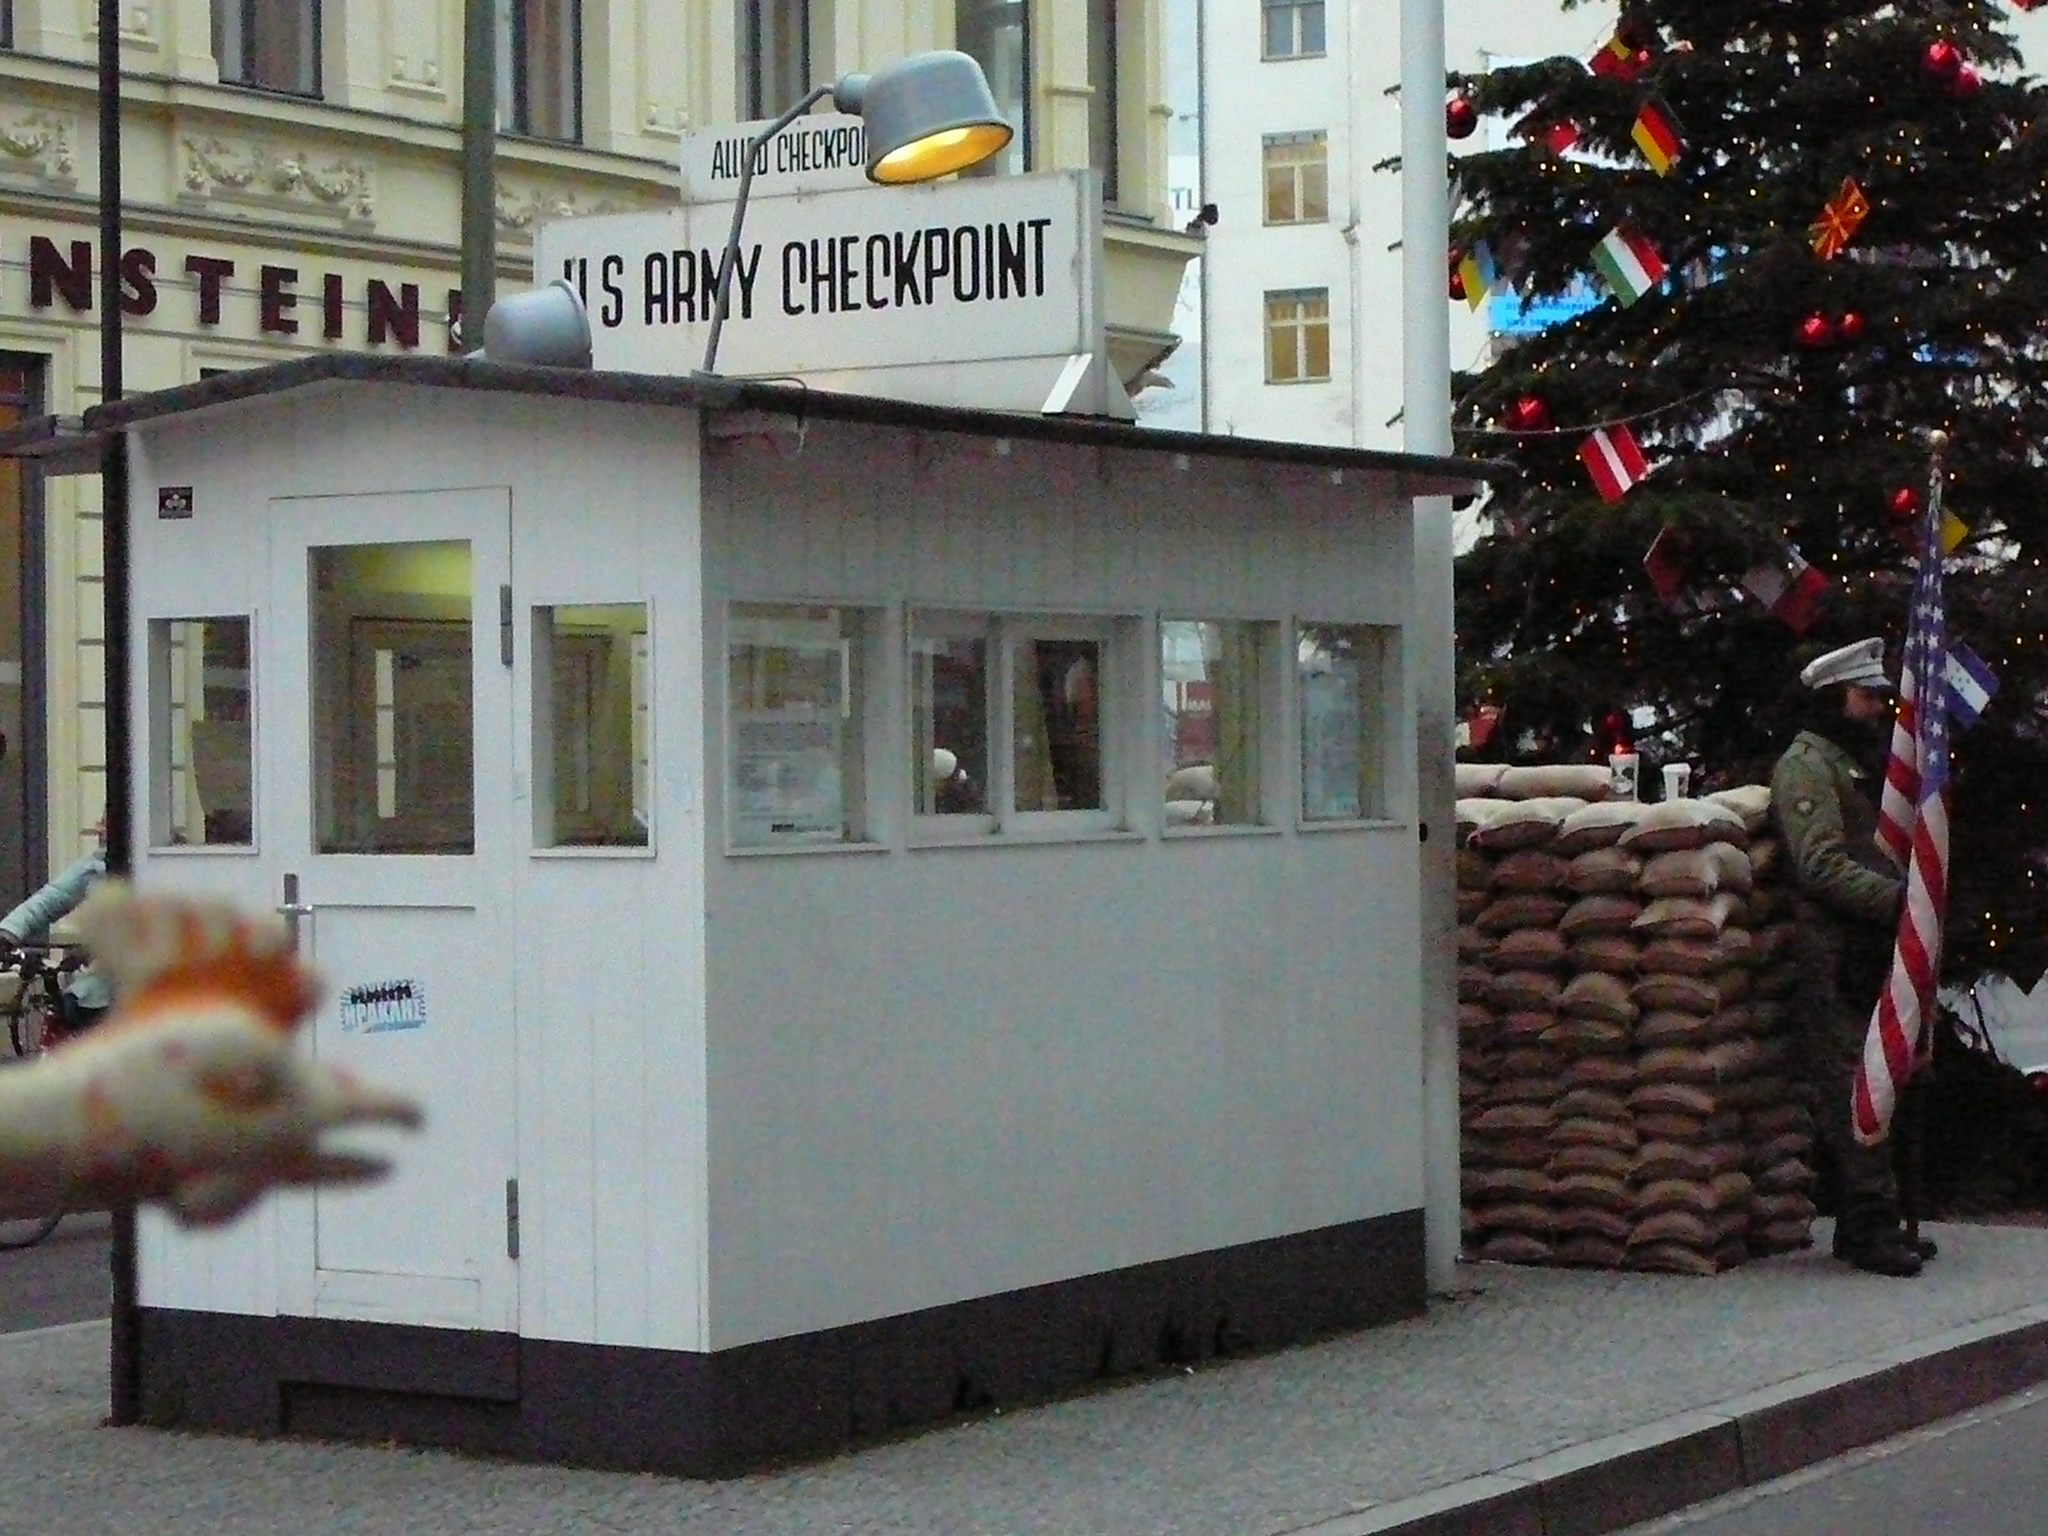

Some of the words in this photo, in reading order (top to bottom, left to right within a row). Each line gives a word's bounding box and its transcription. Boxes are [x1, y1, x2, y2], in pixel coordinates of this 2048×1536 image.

[711, 136, 768, 180] ALLID
[777, 126, 869, 173] CHECKPOI
[644, 243, 762, 326] ARMY
[782, 218, 1052, 316] CHECKPOINT
